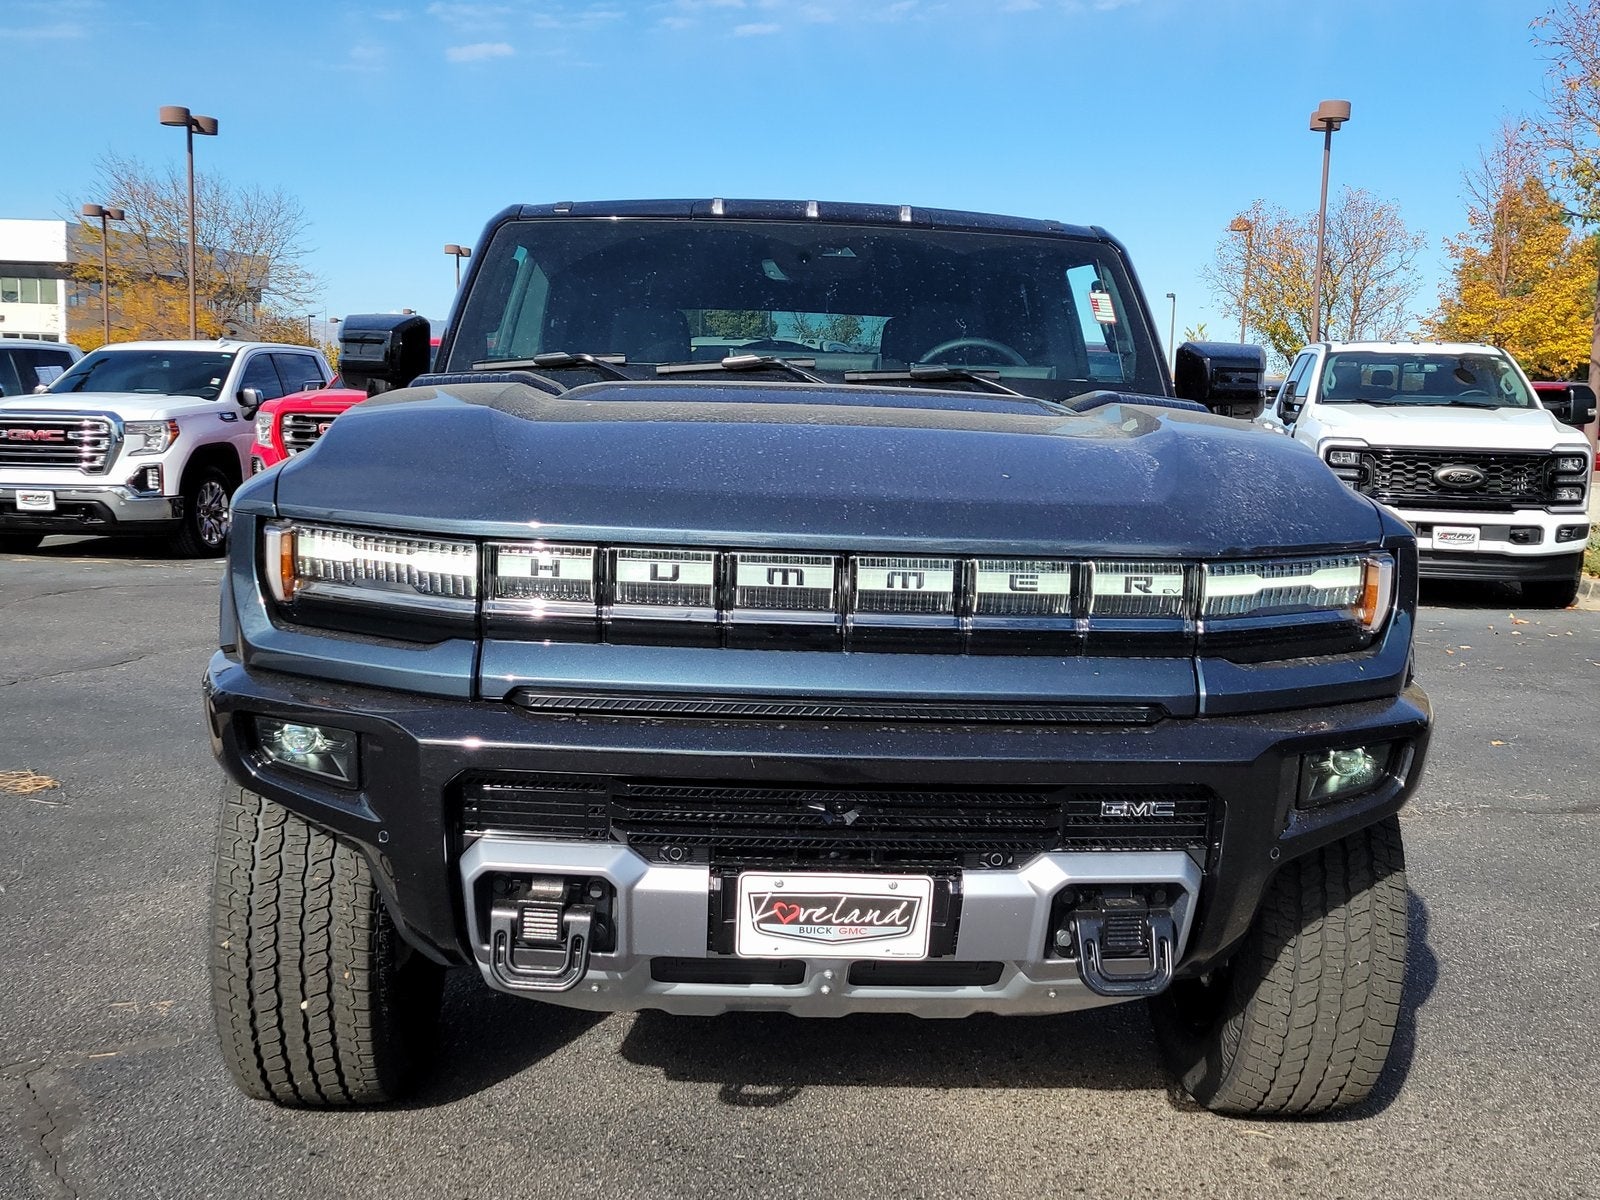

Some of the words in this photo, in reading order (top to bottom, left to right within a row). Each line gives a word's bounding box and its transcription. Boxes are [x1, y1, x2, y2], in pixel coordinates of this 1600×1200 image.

[7, 428, 65, 441] GMC
[1448, 471, 1474, 482] Ford
[530, 557, 1153, 594] HUMMER
[1101, 801, 1176, 817] GMC
[751, 891, 911, 926] Loveland
[798, 926, 832, 935] BUICK
[838, 926, 868, 935] GMC
